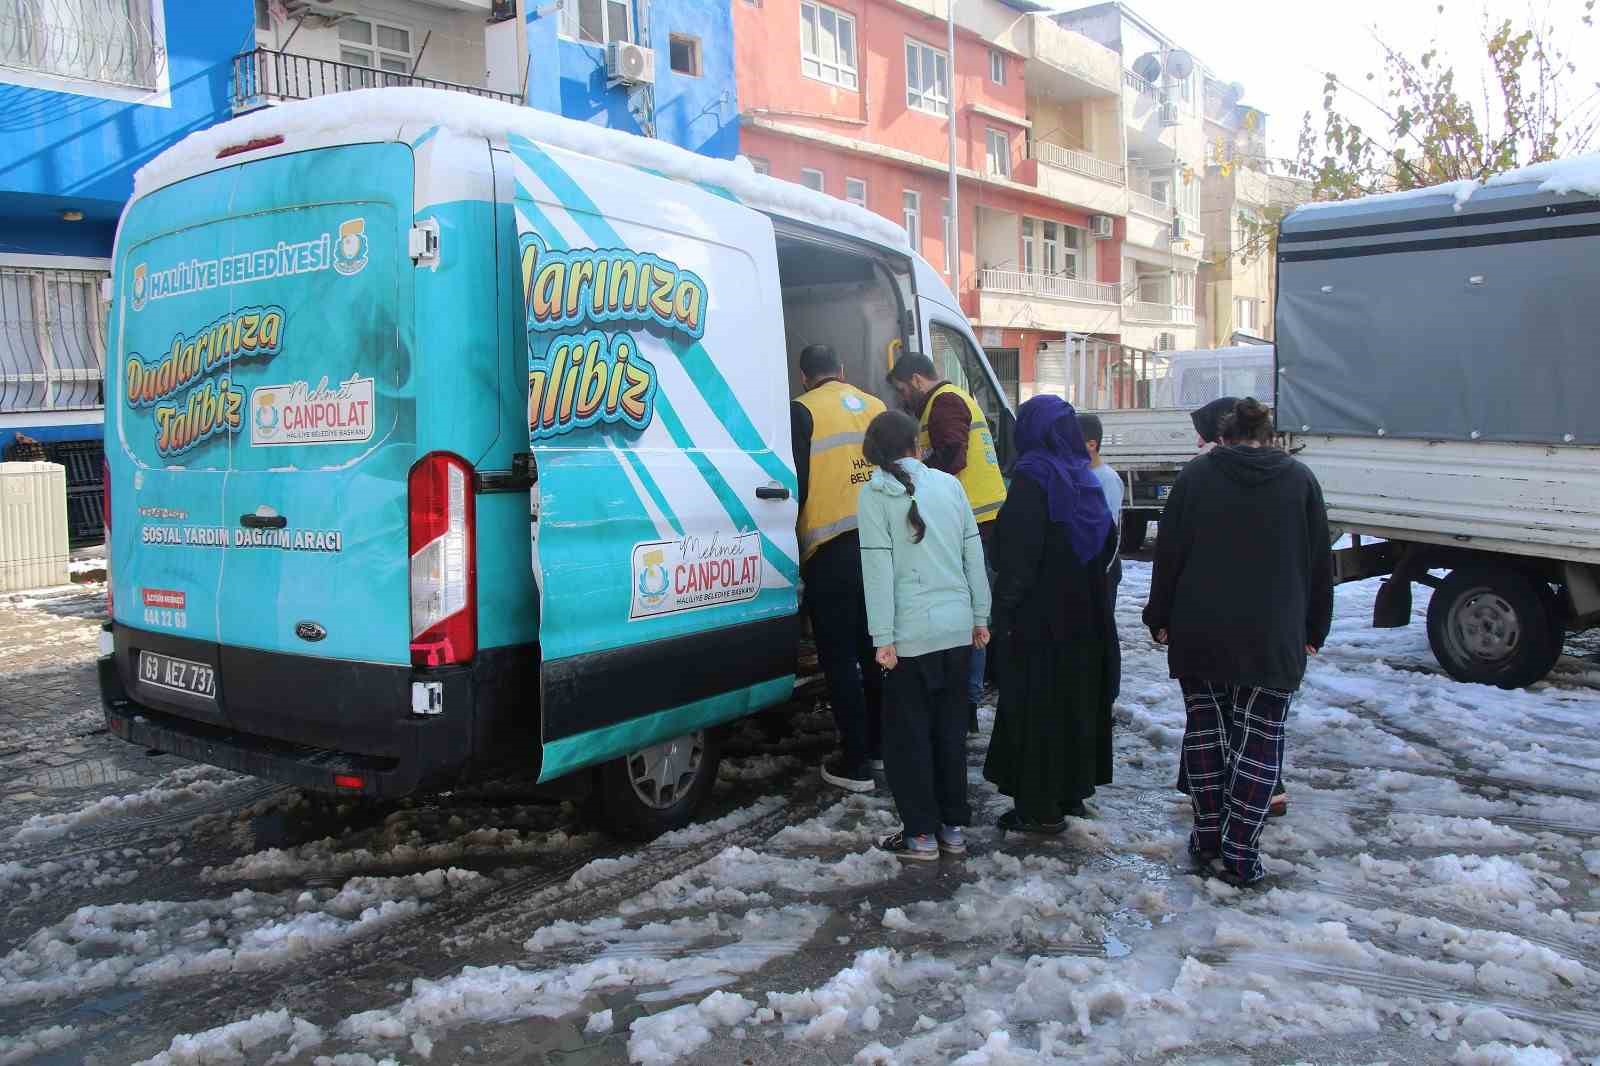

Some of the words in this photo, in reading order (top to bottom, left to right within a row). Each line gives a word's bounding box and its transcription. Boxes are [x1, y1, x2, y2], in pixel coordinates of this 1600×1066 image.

[150, 259, 217, 298] HALİLİYE
[220, 233, 330, 285] BELEDİYESİ
[126, 310, 283, 406] Dualarınıza
[287, 372, 360, 402] Mehmet
[156, 377, 243, 452] Talibiz
[283, 400, 369, 430] CANPOLAT
[142, 526, 182, 546] SOSYAL
[183, 527, 229, 547] YARDIM
[293, 530, 342, 551] ARACI
[680, 525, 748, 560] Mehmet
[674, 555, 759, 595] CANPOLAT
[145, 656, 158, 680] 63
[165, 660, 187, 688] AEZ
[191, 665, 214, 693] 737
